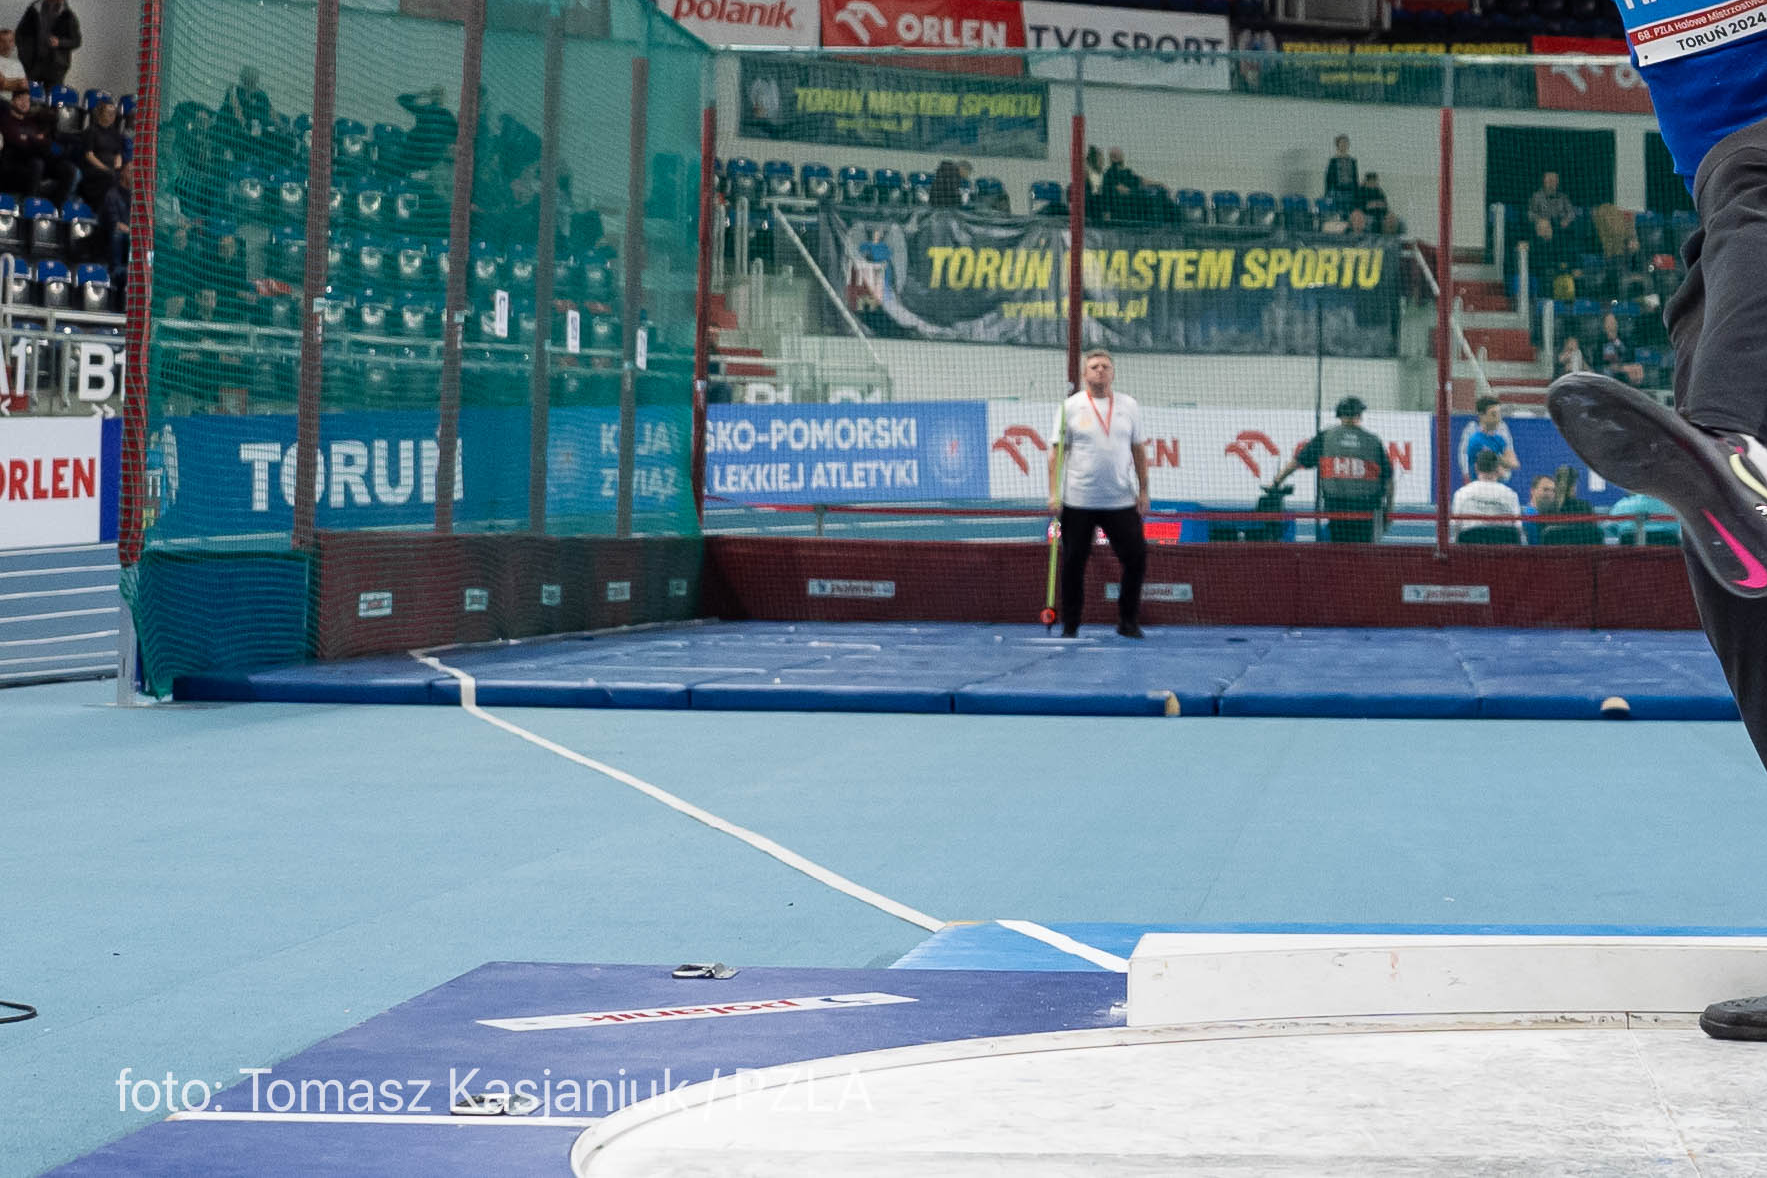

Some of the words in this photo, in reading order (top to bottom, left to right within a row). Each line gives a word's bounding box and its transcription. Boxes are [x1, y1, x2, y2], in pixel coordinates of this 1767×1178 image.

[896, 12, 1007, 48] ORLEN
[1654, 25, 1674, 37] PZLA
[1674, 15, 1707, 31] Halowe
[1676, 25, 1728, 51] TORUŃ
[1728, 11, 1767, 35] 2024
[1112, 31, 1224, 66] SPORT
[1240, 247, 1385, 290] SPORTU
[79, 341, 127, 402] B1
[0, 457, 96, 501] RLEN
[714, 462, 805, 493] LEKKIEJ
[811, 459, 919, 489] ATLETYKI
[579, 999, 802, 1023] polanik
